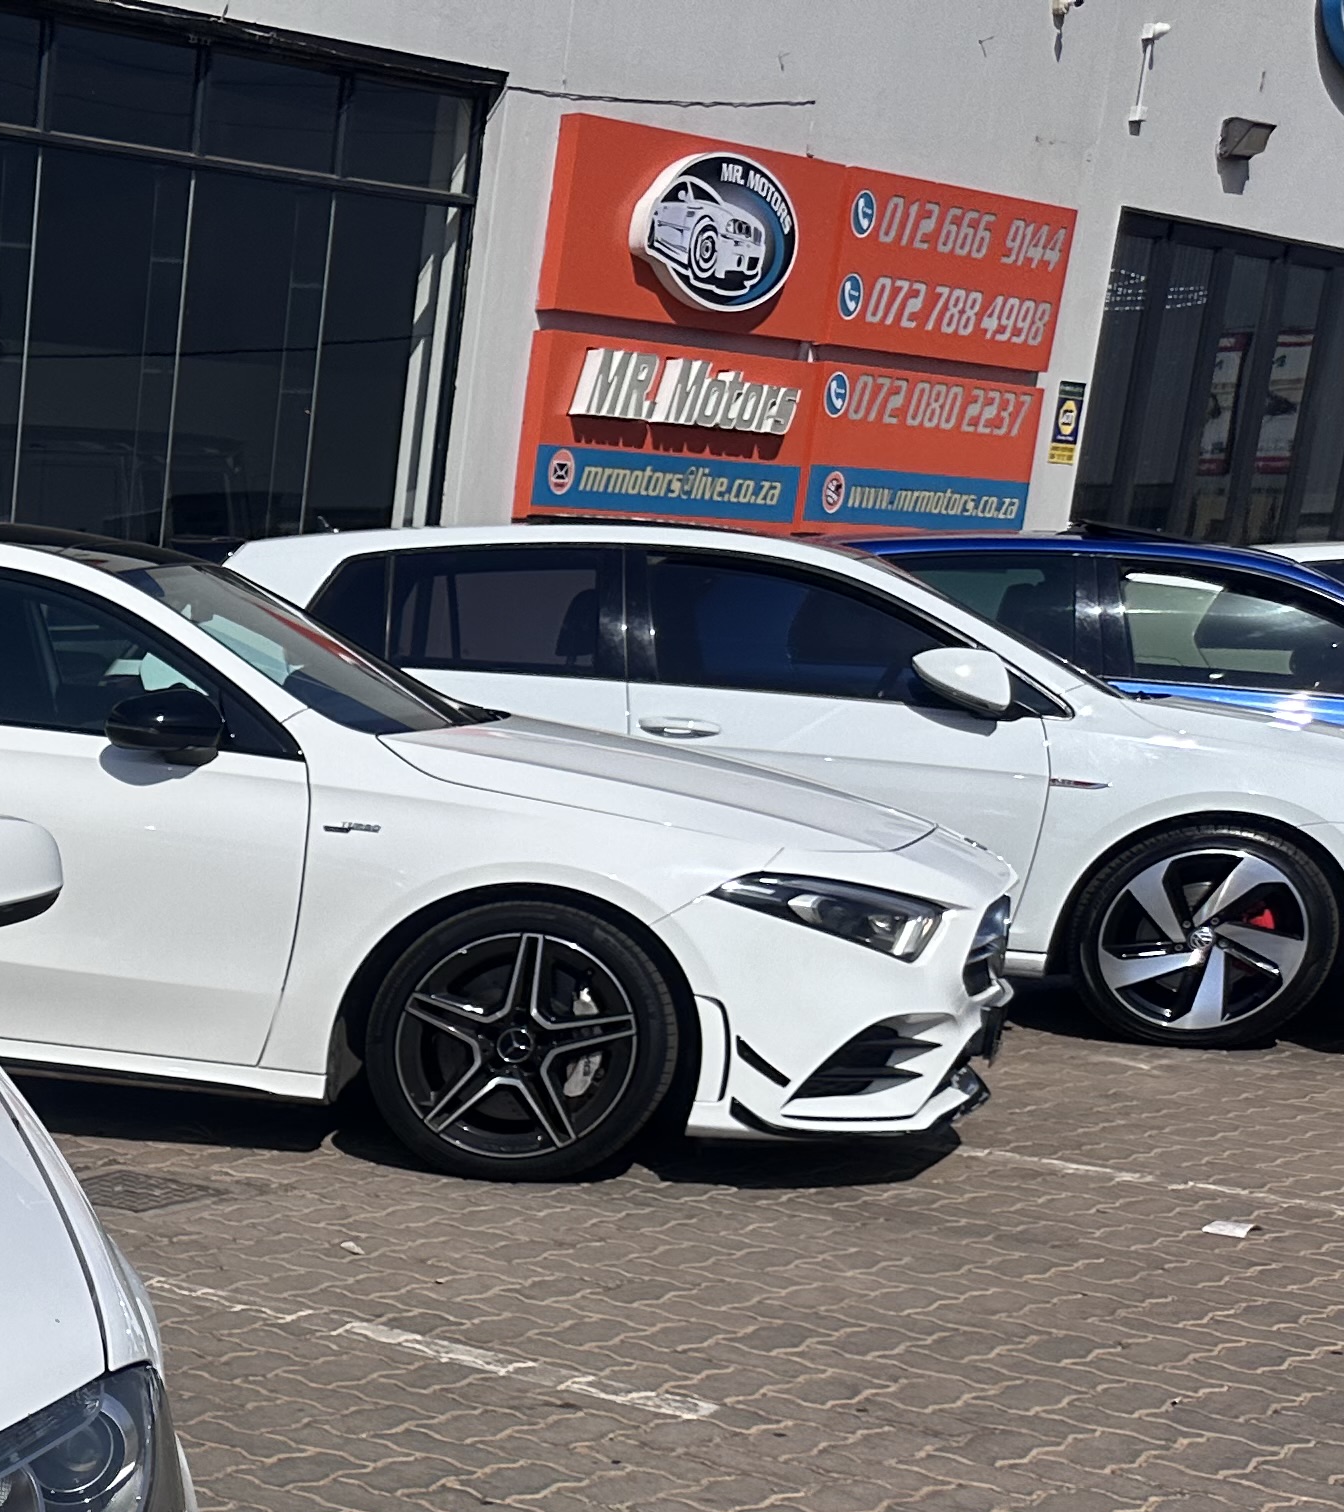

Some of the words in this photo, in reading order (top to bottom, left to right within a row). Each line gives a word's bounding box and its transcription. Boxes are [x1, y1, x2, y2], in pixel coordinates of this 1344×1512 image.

[720, 163, 745, 185] MR.
[746, 170, 792, 235] MOTORS
[878, 195, 940, 250] 012
[937, 206, 997, 259] 666
[1000, 218, 1067, 272] 9144
[865, 275, 928, 328] 072
[924, 284, 984, 336] 788
[980, 293, 1052, 346] 4998
[569, 348, 659, 420] MR.
[648, 357, 802, 435] Motors
[847, 375, 909, 425] 072
[905, 381, 964, 430] 080
[961, 387, 1033, 437] 2237
[579, 465, 782, 506] mrmotors@live.co.za
[847, 485, 1020, 519] www.mrmotors.co.za
